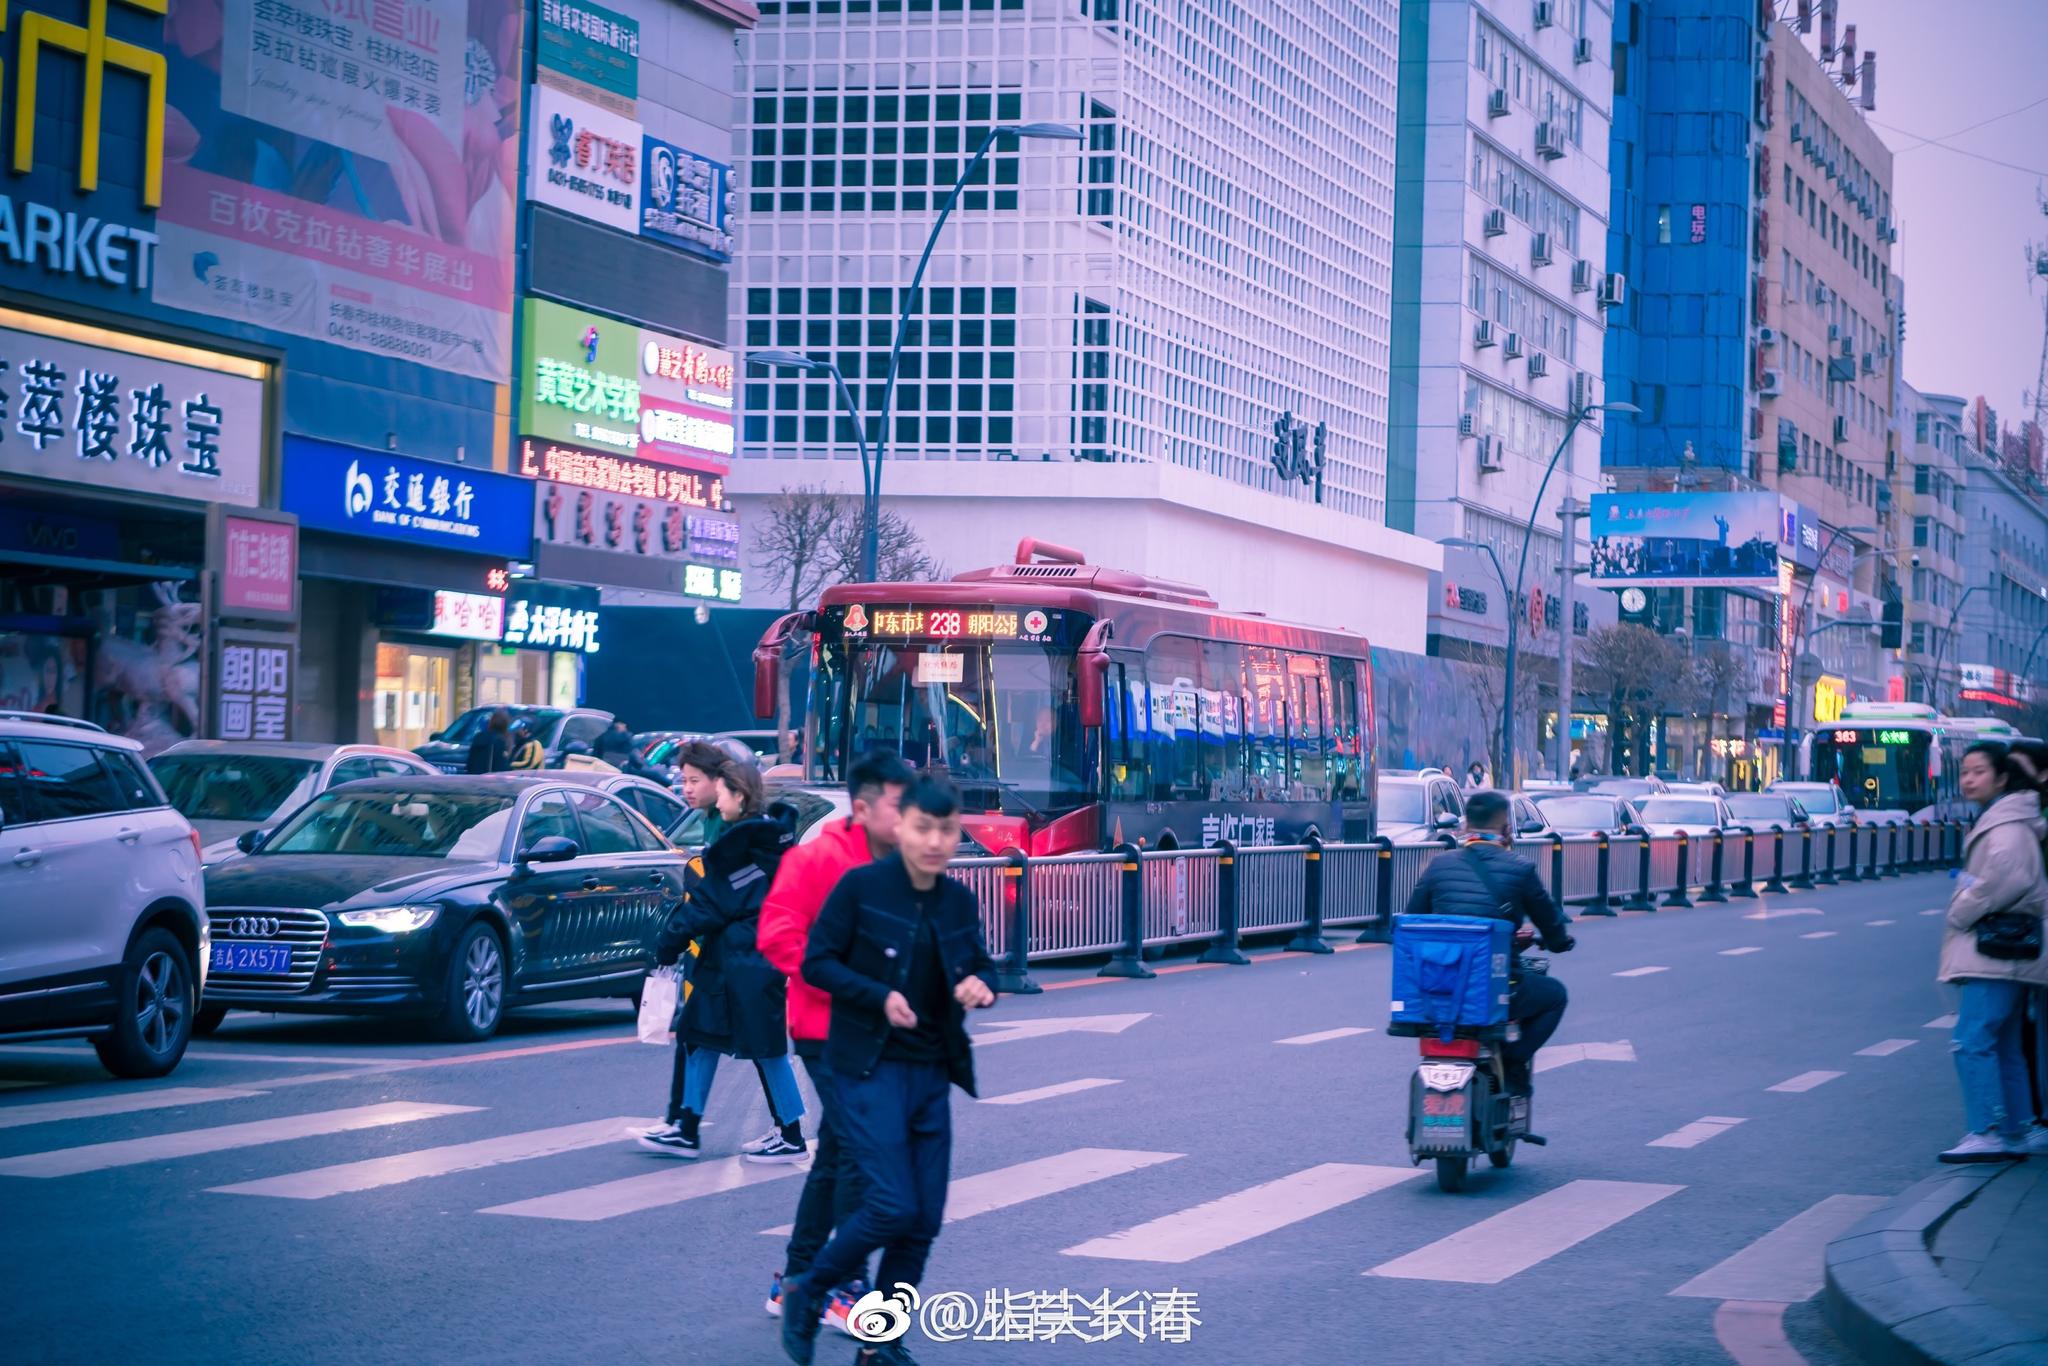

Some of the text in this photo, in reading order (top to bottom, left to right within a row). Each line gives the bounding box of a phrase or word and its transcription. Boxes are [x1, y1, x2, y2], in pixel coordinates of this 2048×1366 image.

[207, 190, 475, 292] 百枚克拉钻奢华展出
[0, 360, 223, 478] 萃楼珠宝
[372, 510, 397, 524] BANK
[930, 612, 961, 635] 238
[223, 644, 289, 694] 朝阳
[222, 695, 286, 740] 画室
